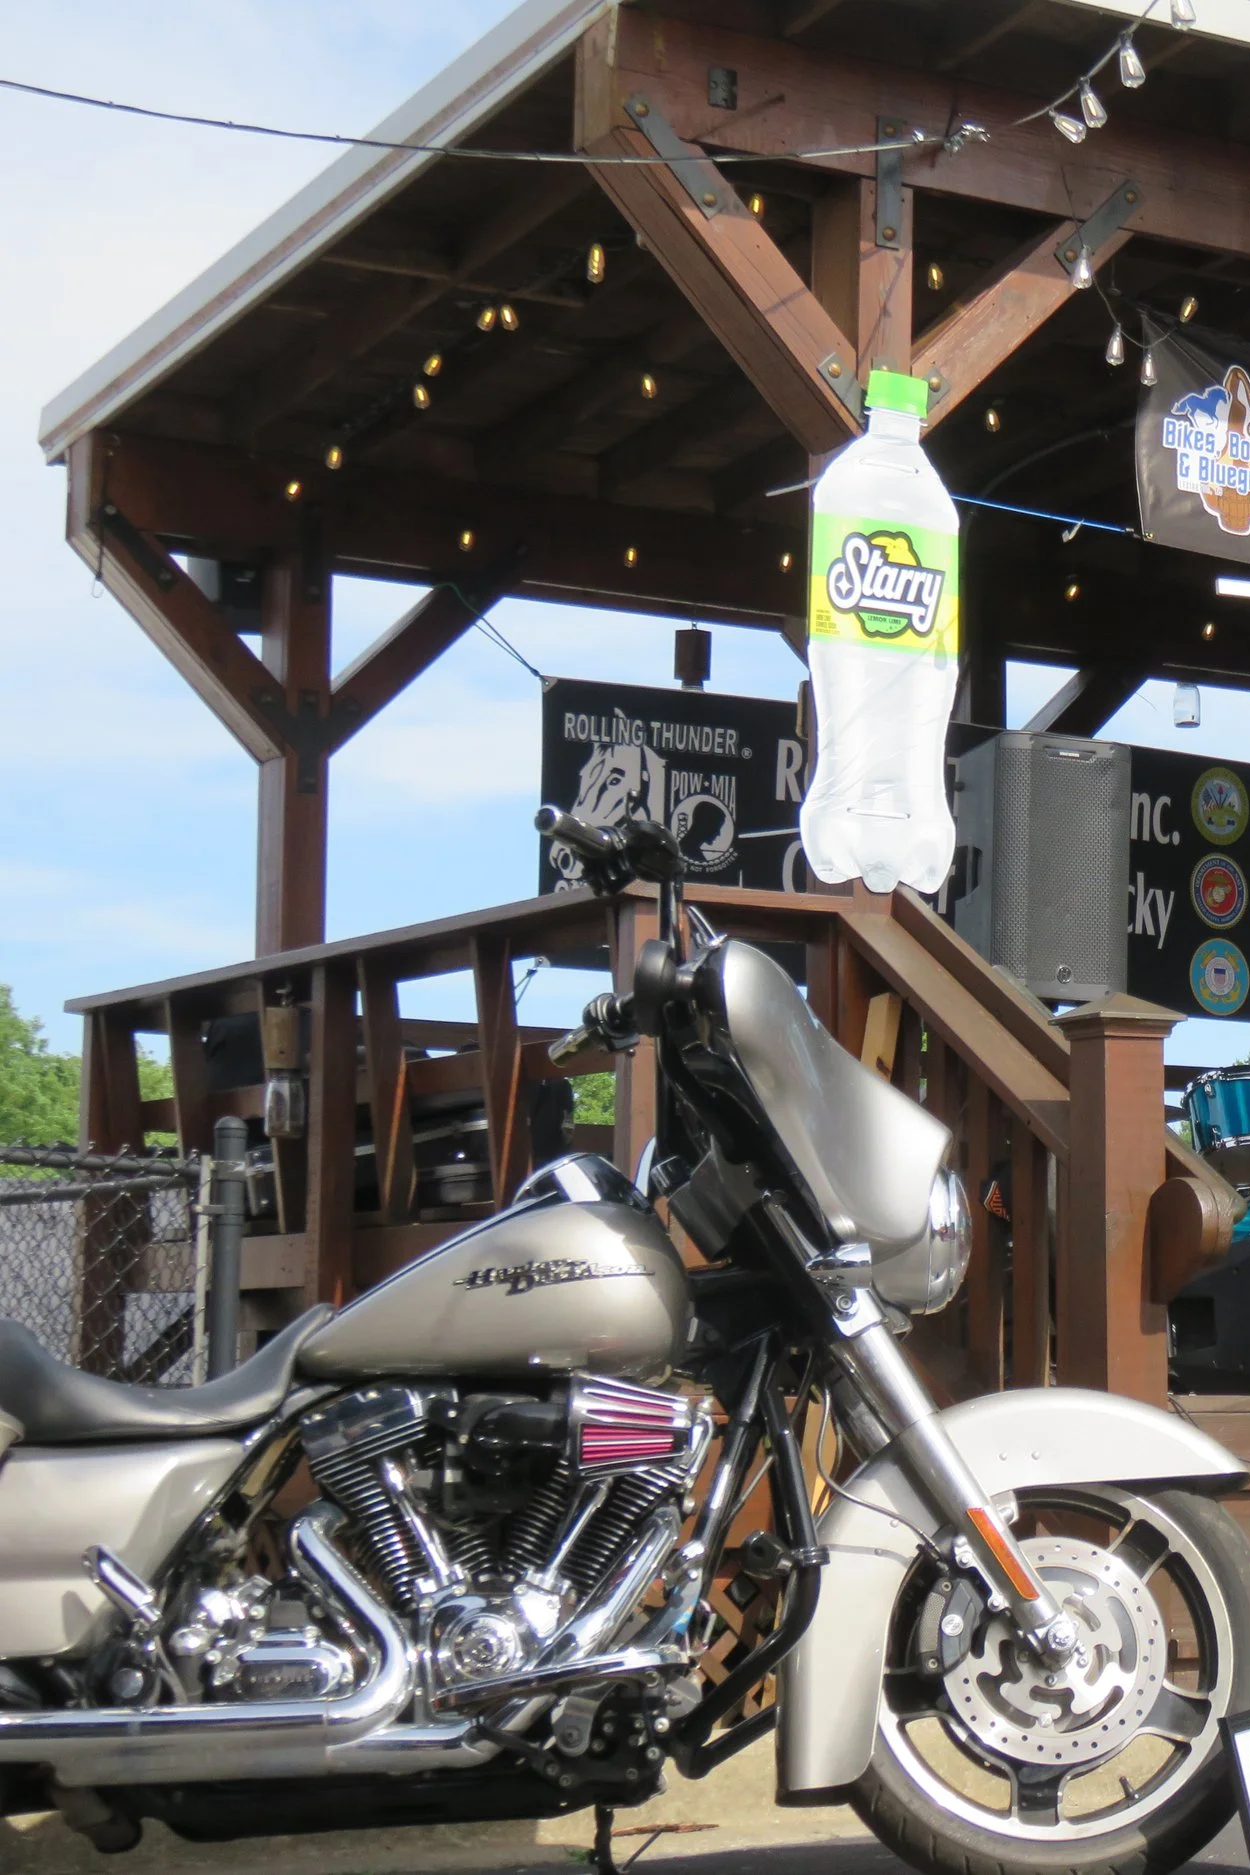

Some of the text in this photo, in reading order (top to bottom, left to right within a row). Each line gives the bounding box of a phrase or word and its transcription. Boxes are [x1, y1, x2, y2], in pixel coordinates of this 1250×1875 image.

[1164, 420, 1221, 458] Bikes,
[1178, 452, 1190, 478] &
[828, 535, 944, 634] Starry
[564, 711, 737, 756] ROLLING THUNDER
[670, 770, 737, 823] POW MIA
[1131, 792, 1181, 846] nc.
